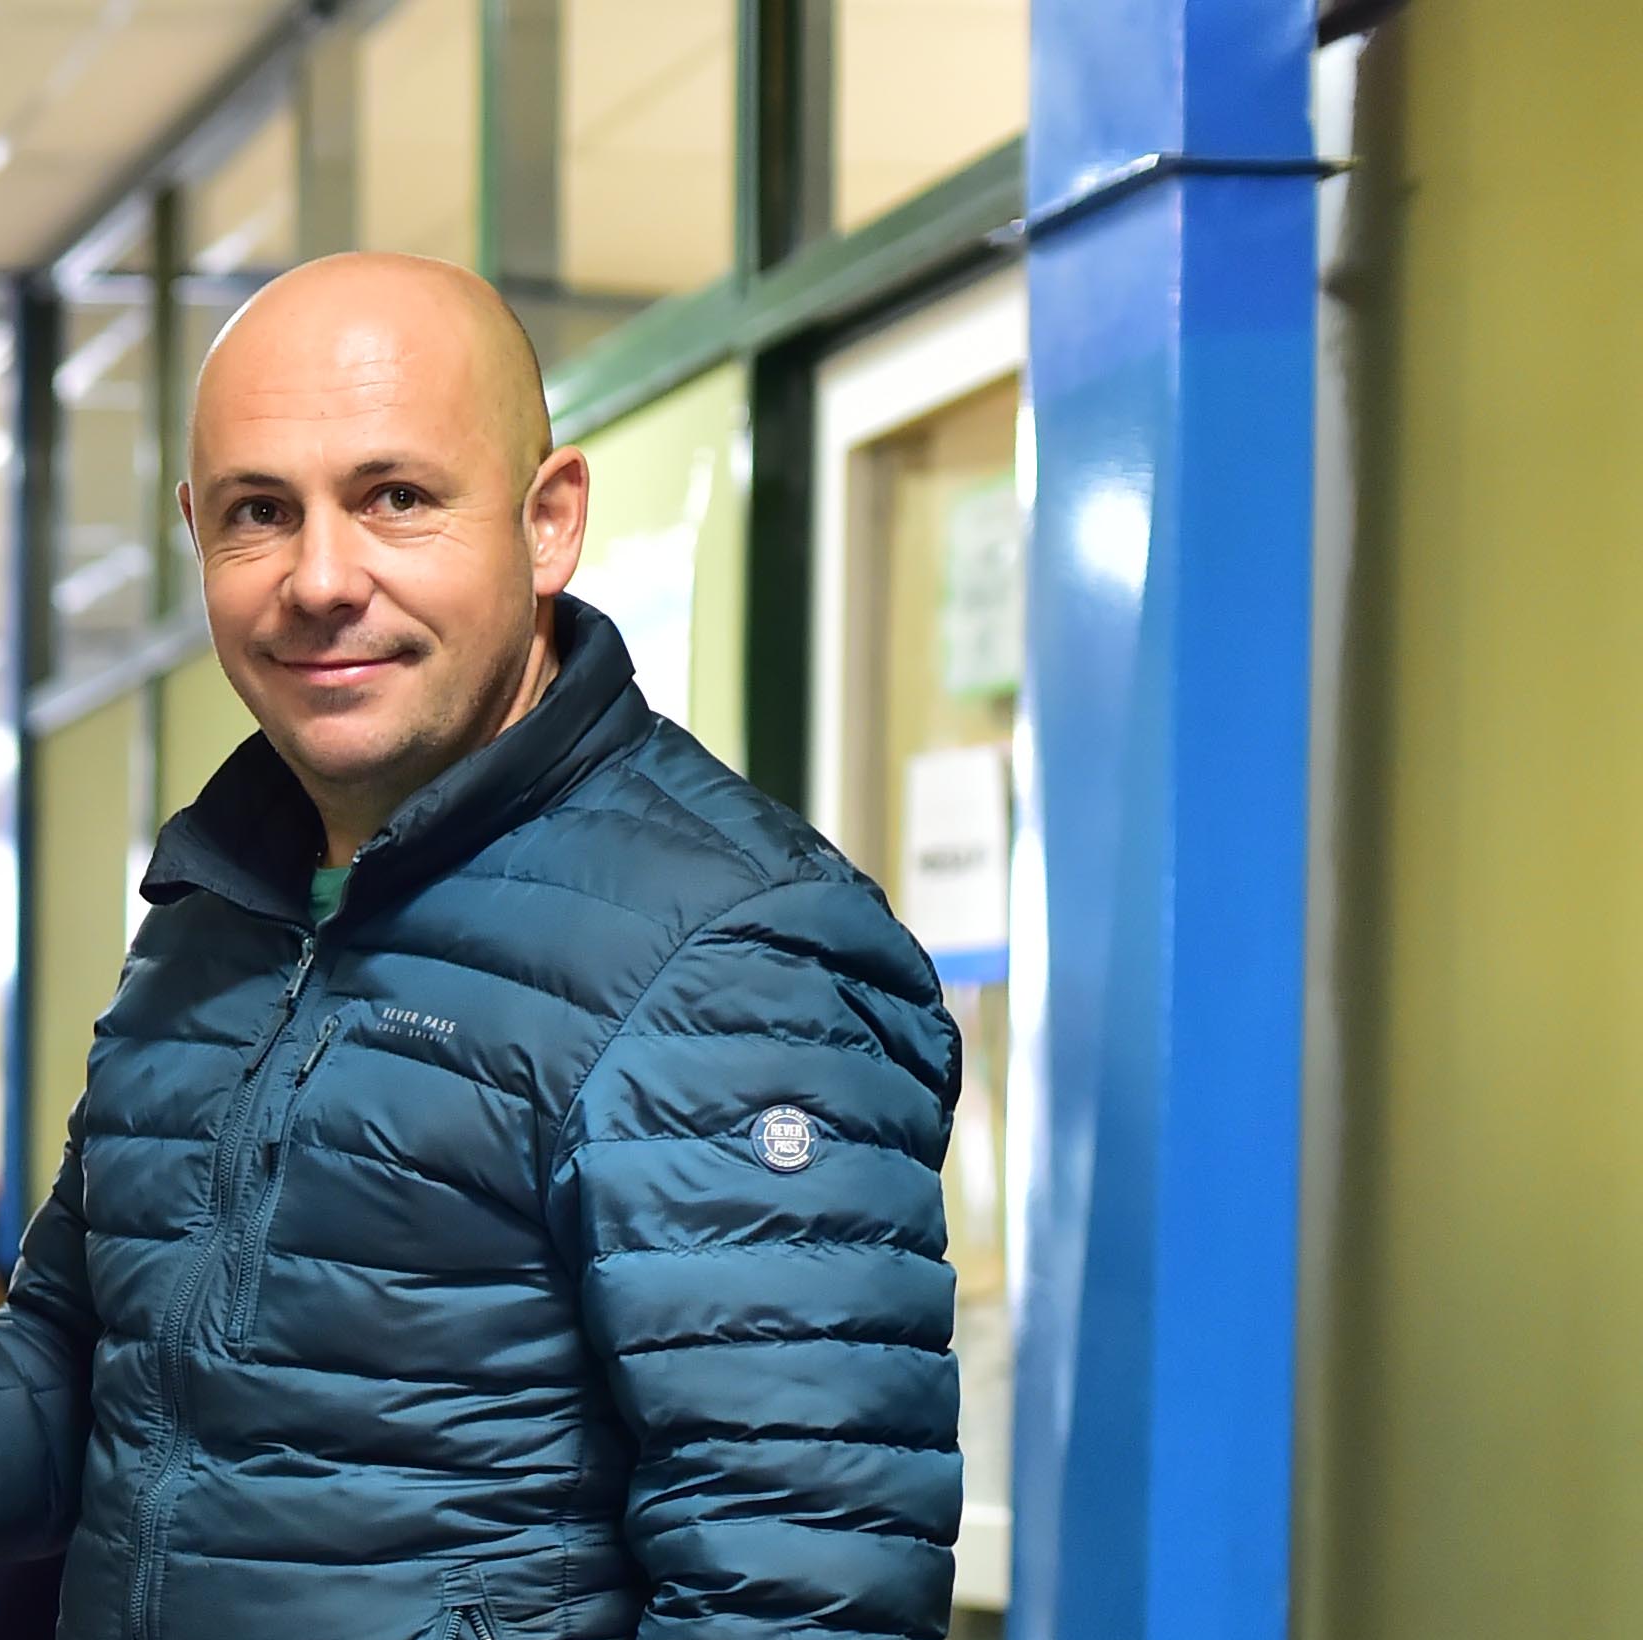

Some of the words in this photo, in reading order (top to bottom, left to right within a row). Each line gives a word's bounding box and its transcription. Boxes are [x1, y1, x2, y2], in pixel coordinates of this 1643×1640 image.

[382, 1007, 419, 1025] REVER
[422, 1015, 457, 1034] PASS
[376, 1023, 402, 1035] COOL
[770, 1124, 802, 1137] REVER
[774, 1141, 800, 1153] PASS
